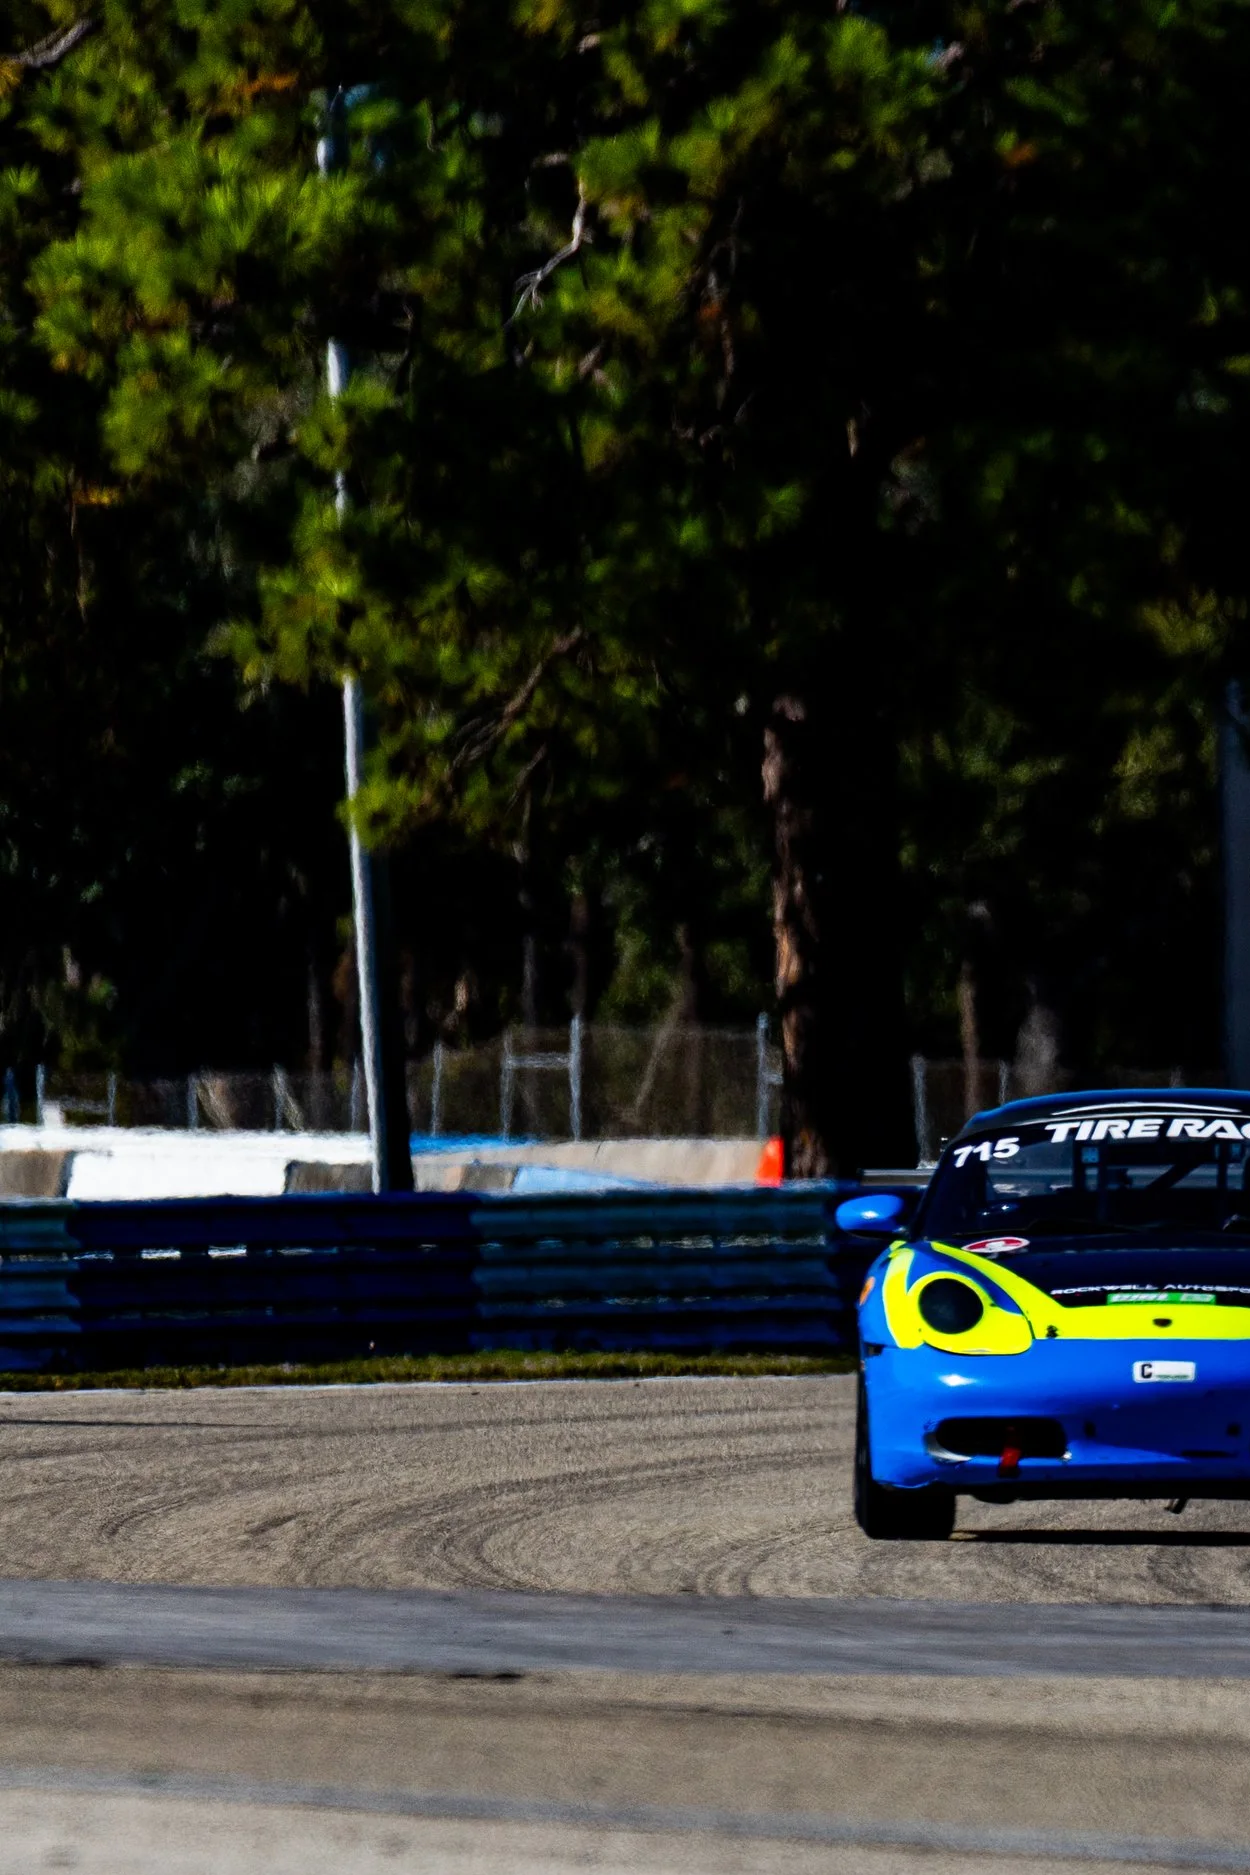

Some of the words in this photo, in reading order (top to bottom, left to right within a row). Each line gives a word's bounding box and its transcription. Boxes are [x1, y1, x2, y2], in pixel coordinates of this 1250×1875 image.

[1045, 1118, 1165, 1143] TIRE
[954, 1137, 1020, 1168] 715
[1050, 1283, 1159, 1295] ROCKWELL
[1141, 1363, 1152, 1379] C
